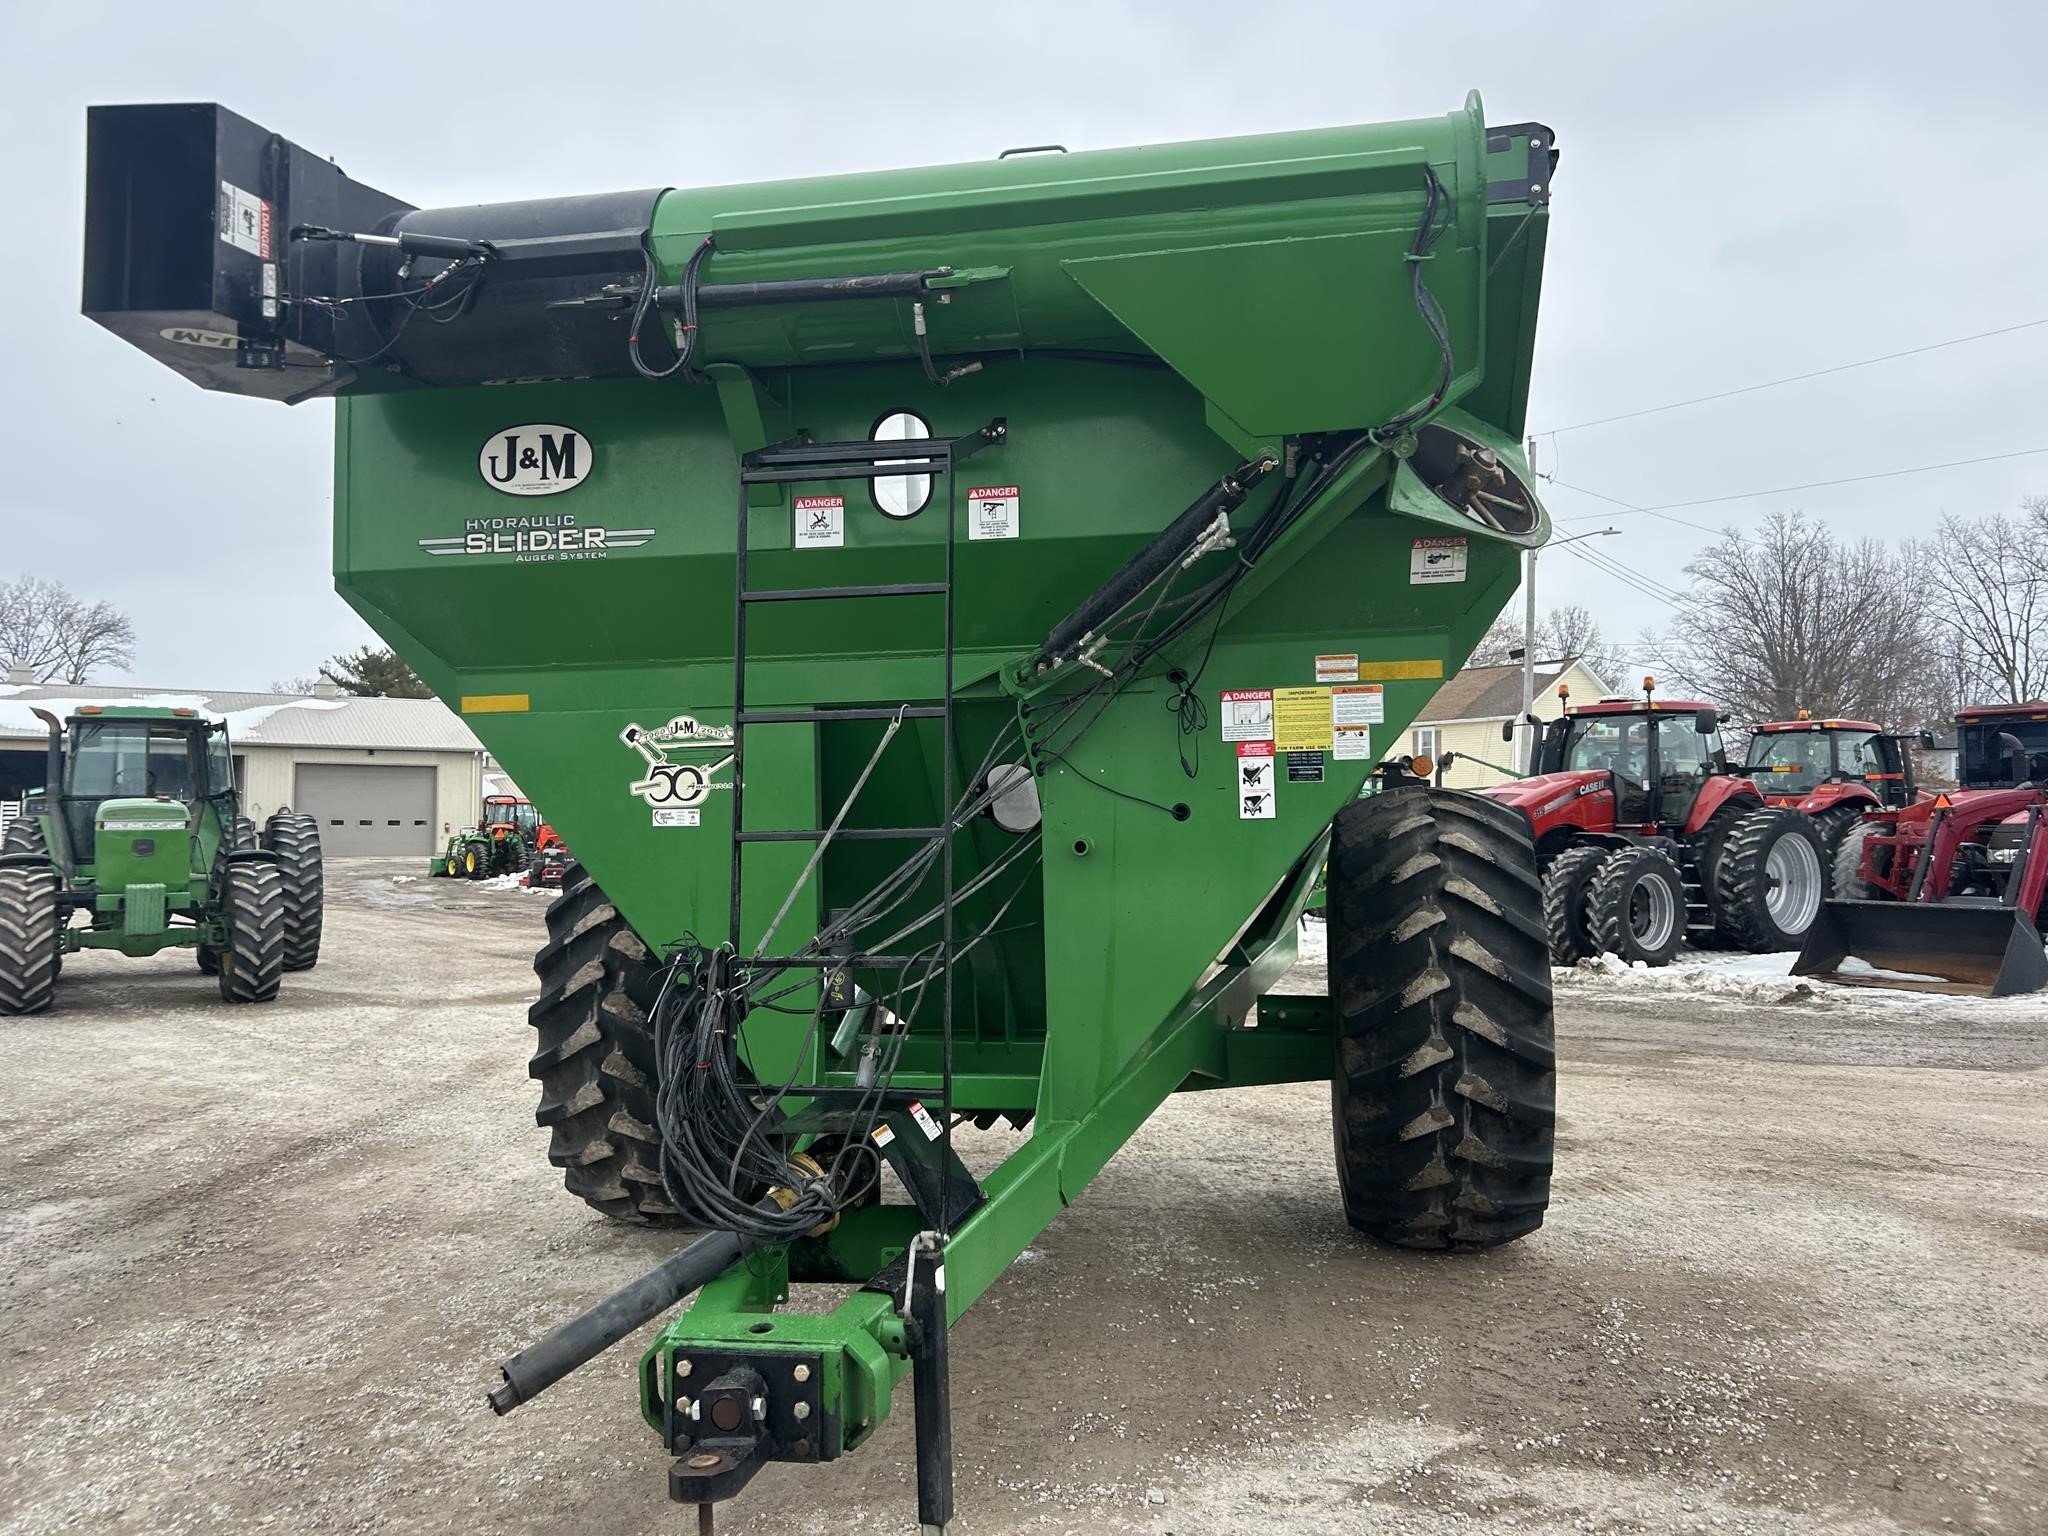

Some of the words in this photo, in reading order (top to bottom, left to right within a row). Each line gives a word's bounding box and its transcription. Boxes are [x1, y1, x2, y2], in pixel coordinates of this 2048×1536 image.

[261, 211, 271, 258] DANGER
[488, 433, 578, 483] J&M
[979, 487, 1018, 498] DANGER
[804, 498, 843, 508] DANGER
[466, 515, 575, 530] HYDRAULIC
[465, 528, 608, 554] SLIDER
[1424, 537, 1467, 547] DANGER
[1232, 691, 1271, 700] DANGER
[670, 721, 694, 735] J&M
[1580, 782, 1599, 795] CASE
